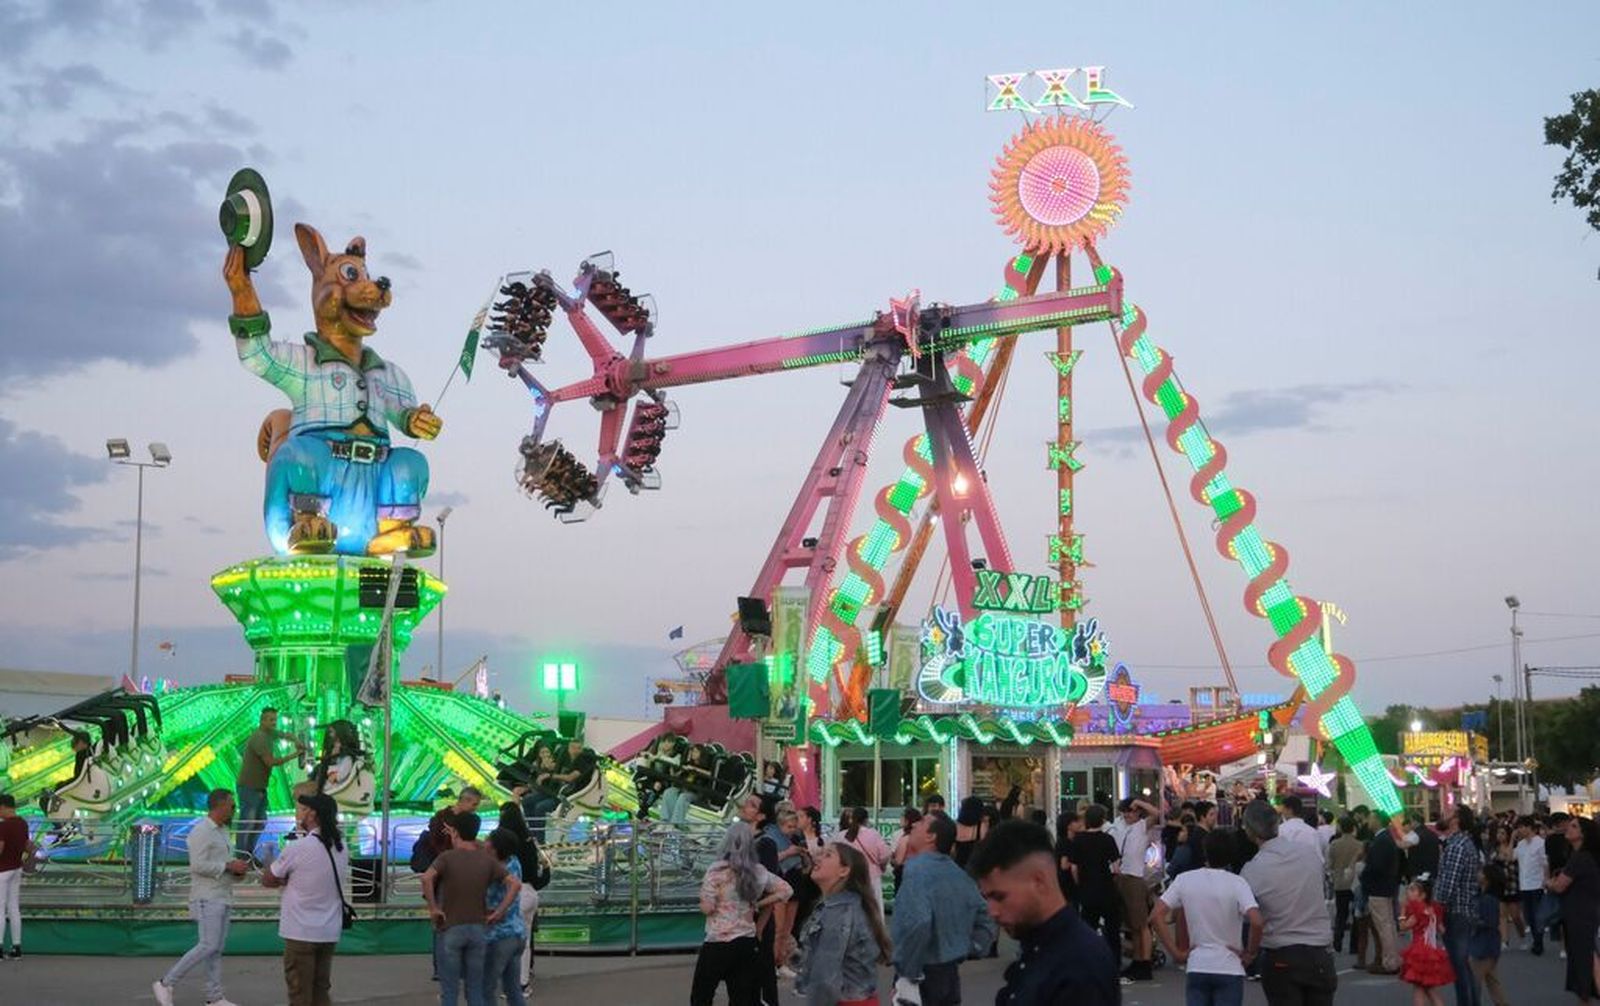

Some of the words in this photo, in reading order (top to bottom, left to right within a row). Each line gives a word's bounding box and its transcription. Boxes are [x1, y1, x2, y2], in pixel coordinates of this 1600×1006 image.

[986, 66, 1134, 113] XXL
[973, 571, 1053, 613] XXL
[974, 614, 1059, 655] SUPER
[963, 641, 1072, 705] KANGURO
